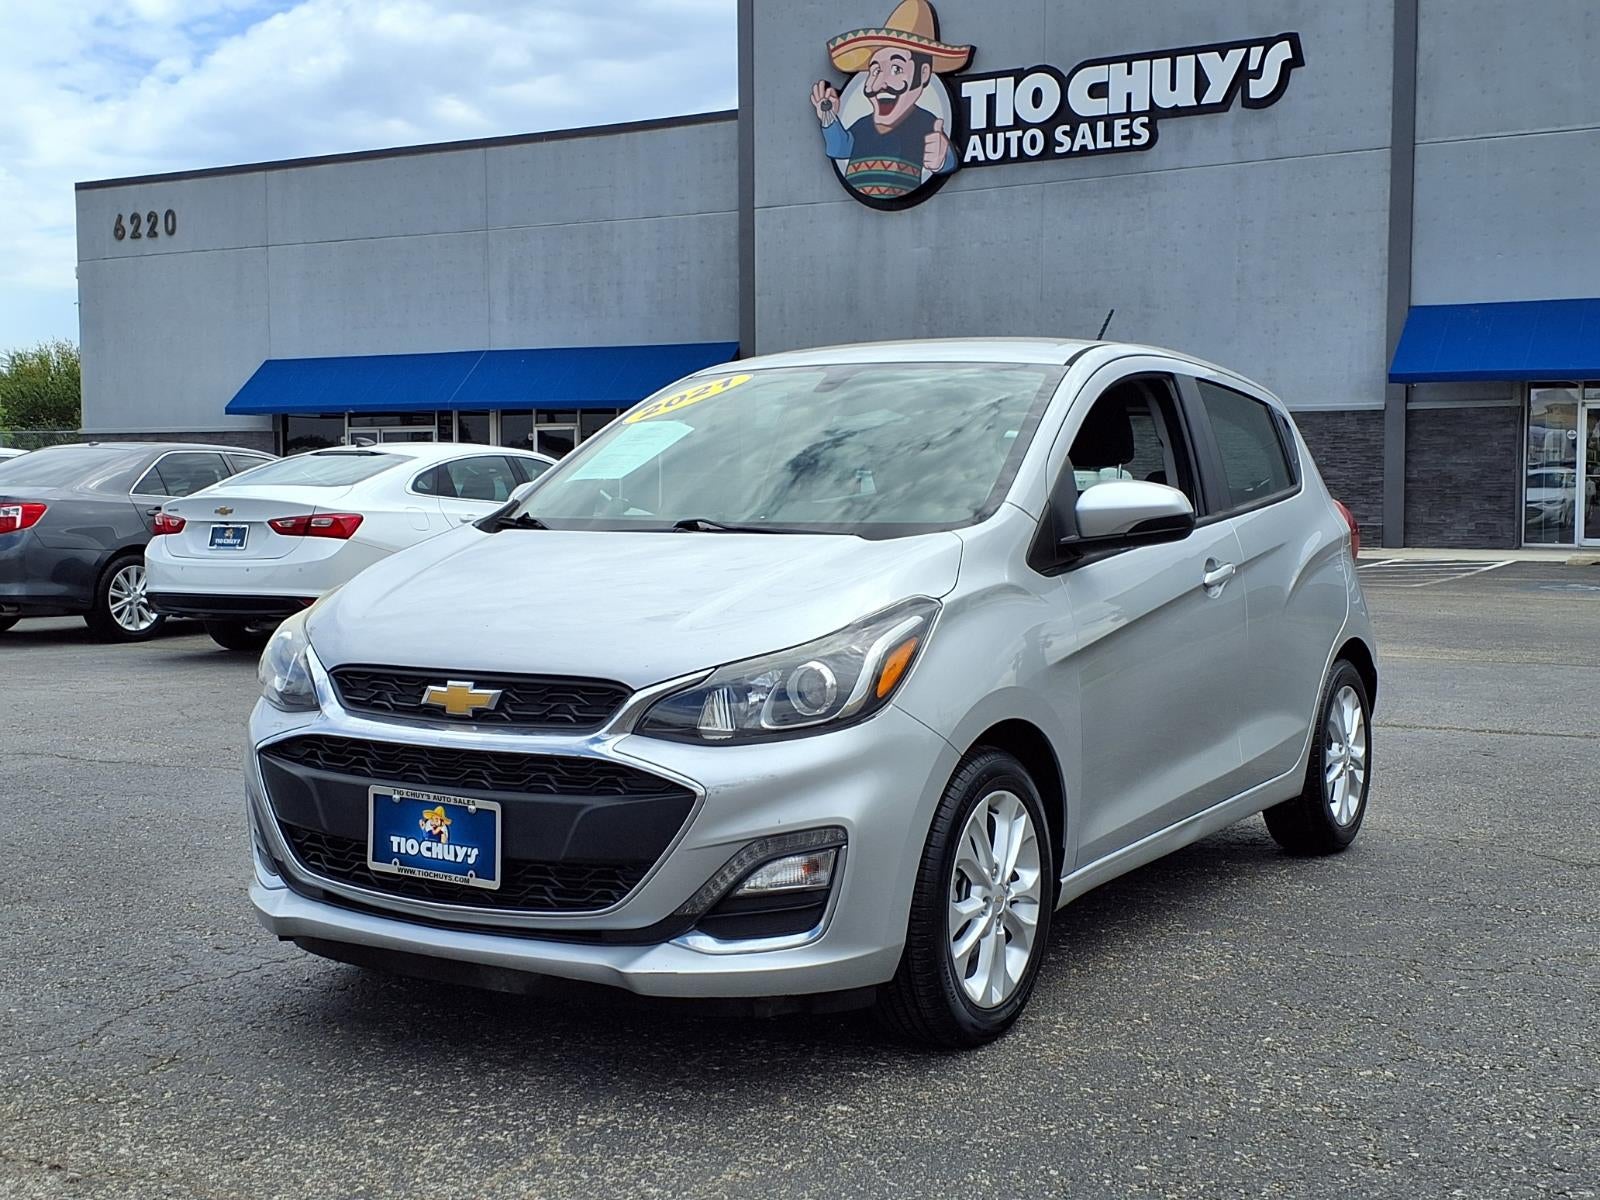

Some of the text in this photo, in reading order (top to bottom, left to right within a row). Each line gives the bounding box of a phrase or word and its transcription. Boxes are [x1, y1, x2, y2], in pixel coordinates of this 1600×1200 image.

[960, 40, 1293, 131] TIO CHUY'S
[963, 116, 1150, 163] AUTO SALES
[113, 208, 177, 241] 6220
[639, 378, 733, 419] 2021
[392, 788, 476, 807] TIO CHUY'S AUTO SALES
[390, 835, 480, 865] TIO CHUY'S
[397, 866, 471, 885] WWW.TIOCHUYS.COM
